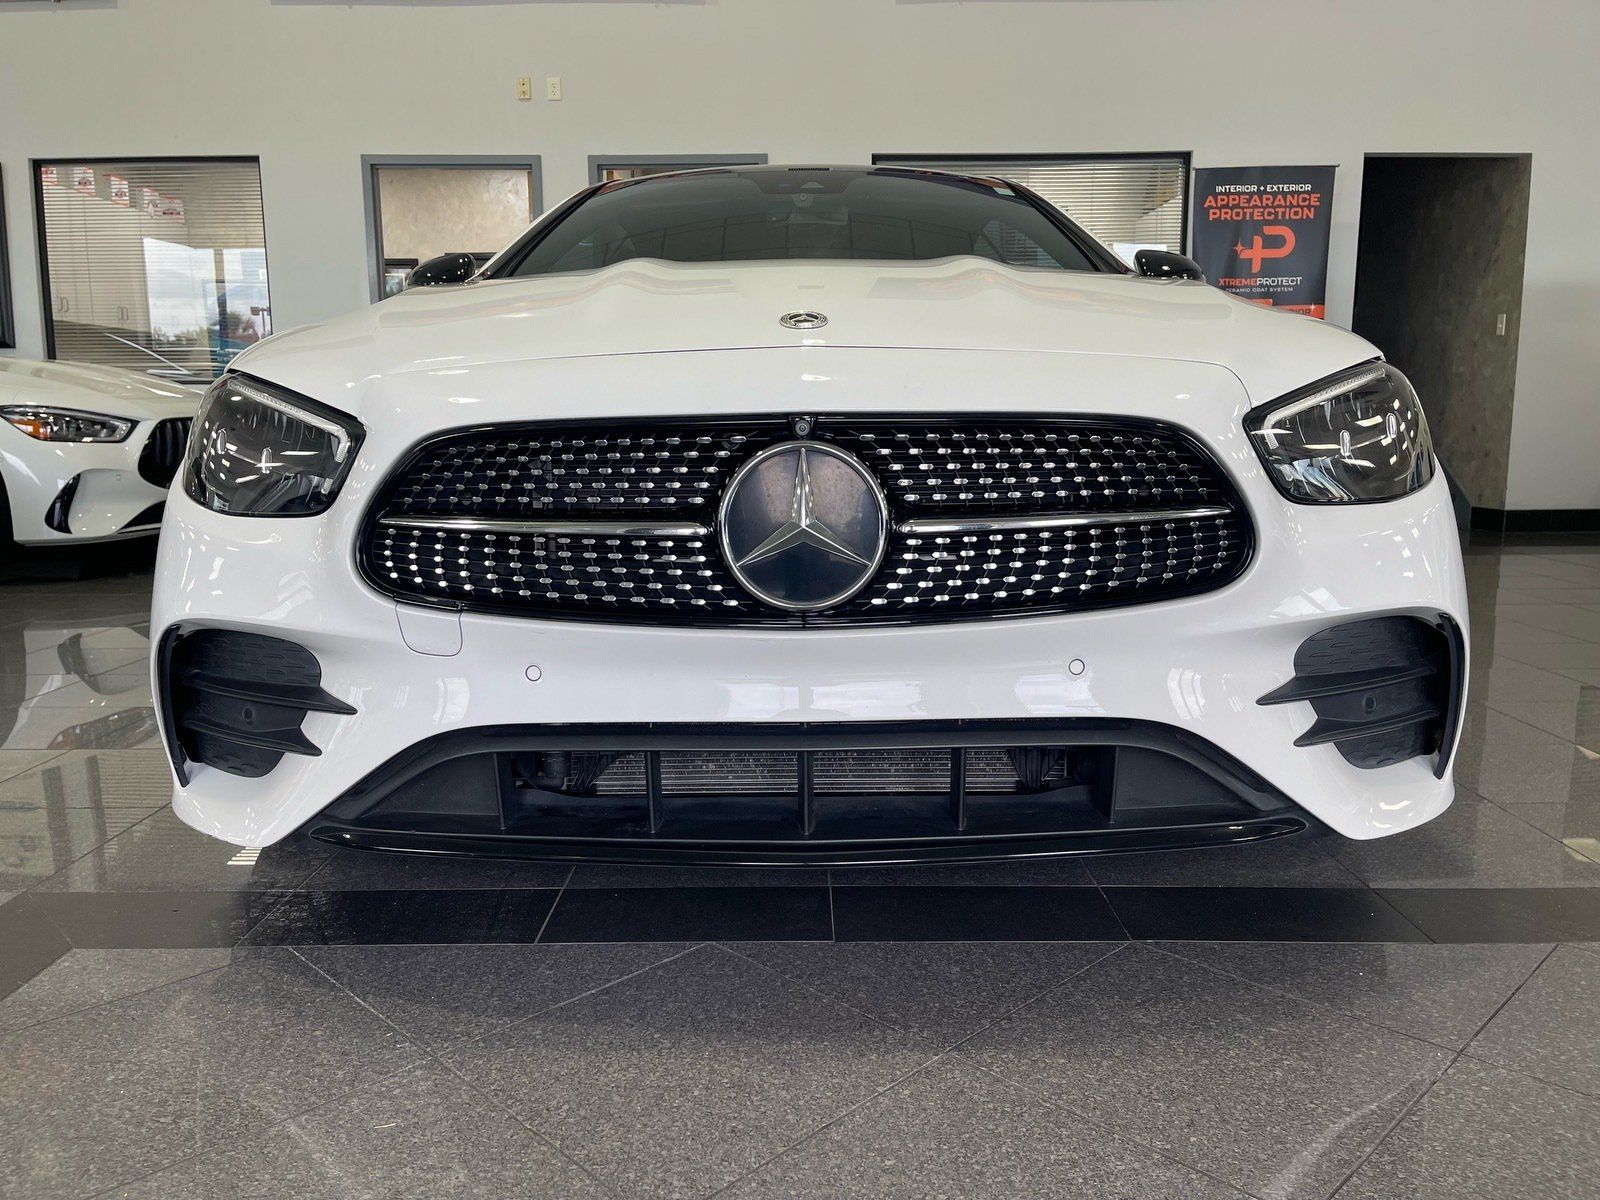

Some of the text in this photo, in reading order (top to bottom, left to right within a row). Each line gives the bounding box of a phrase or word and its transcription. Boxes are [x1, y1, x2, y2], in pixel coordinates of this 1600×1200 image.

[1216, 185, 1257, 193] INTERIOR
[1267, 184, 1312, 192] EXTERIOR
[1204, 194, 1320, 207] APPEARANCE
[1209, 207, 1315, 221] PROTECTION
